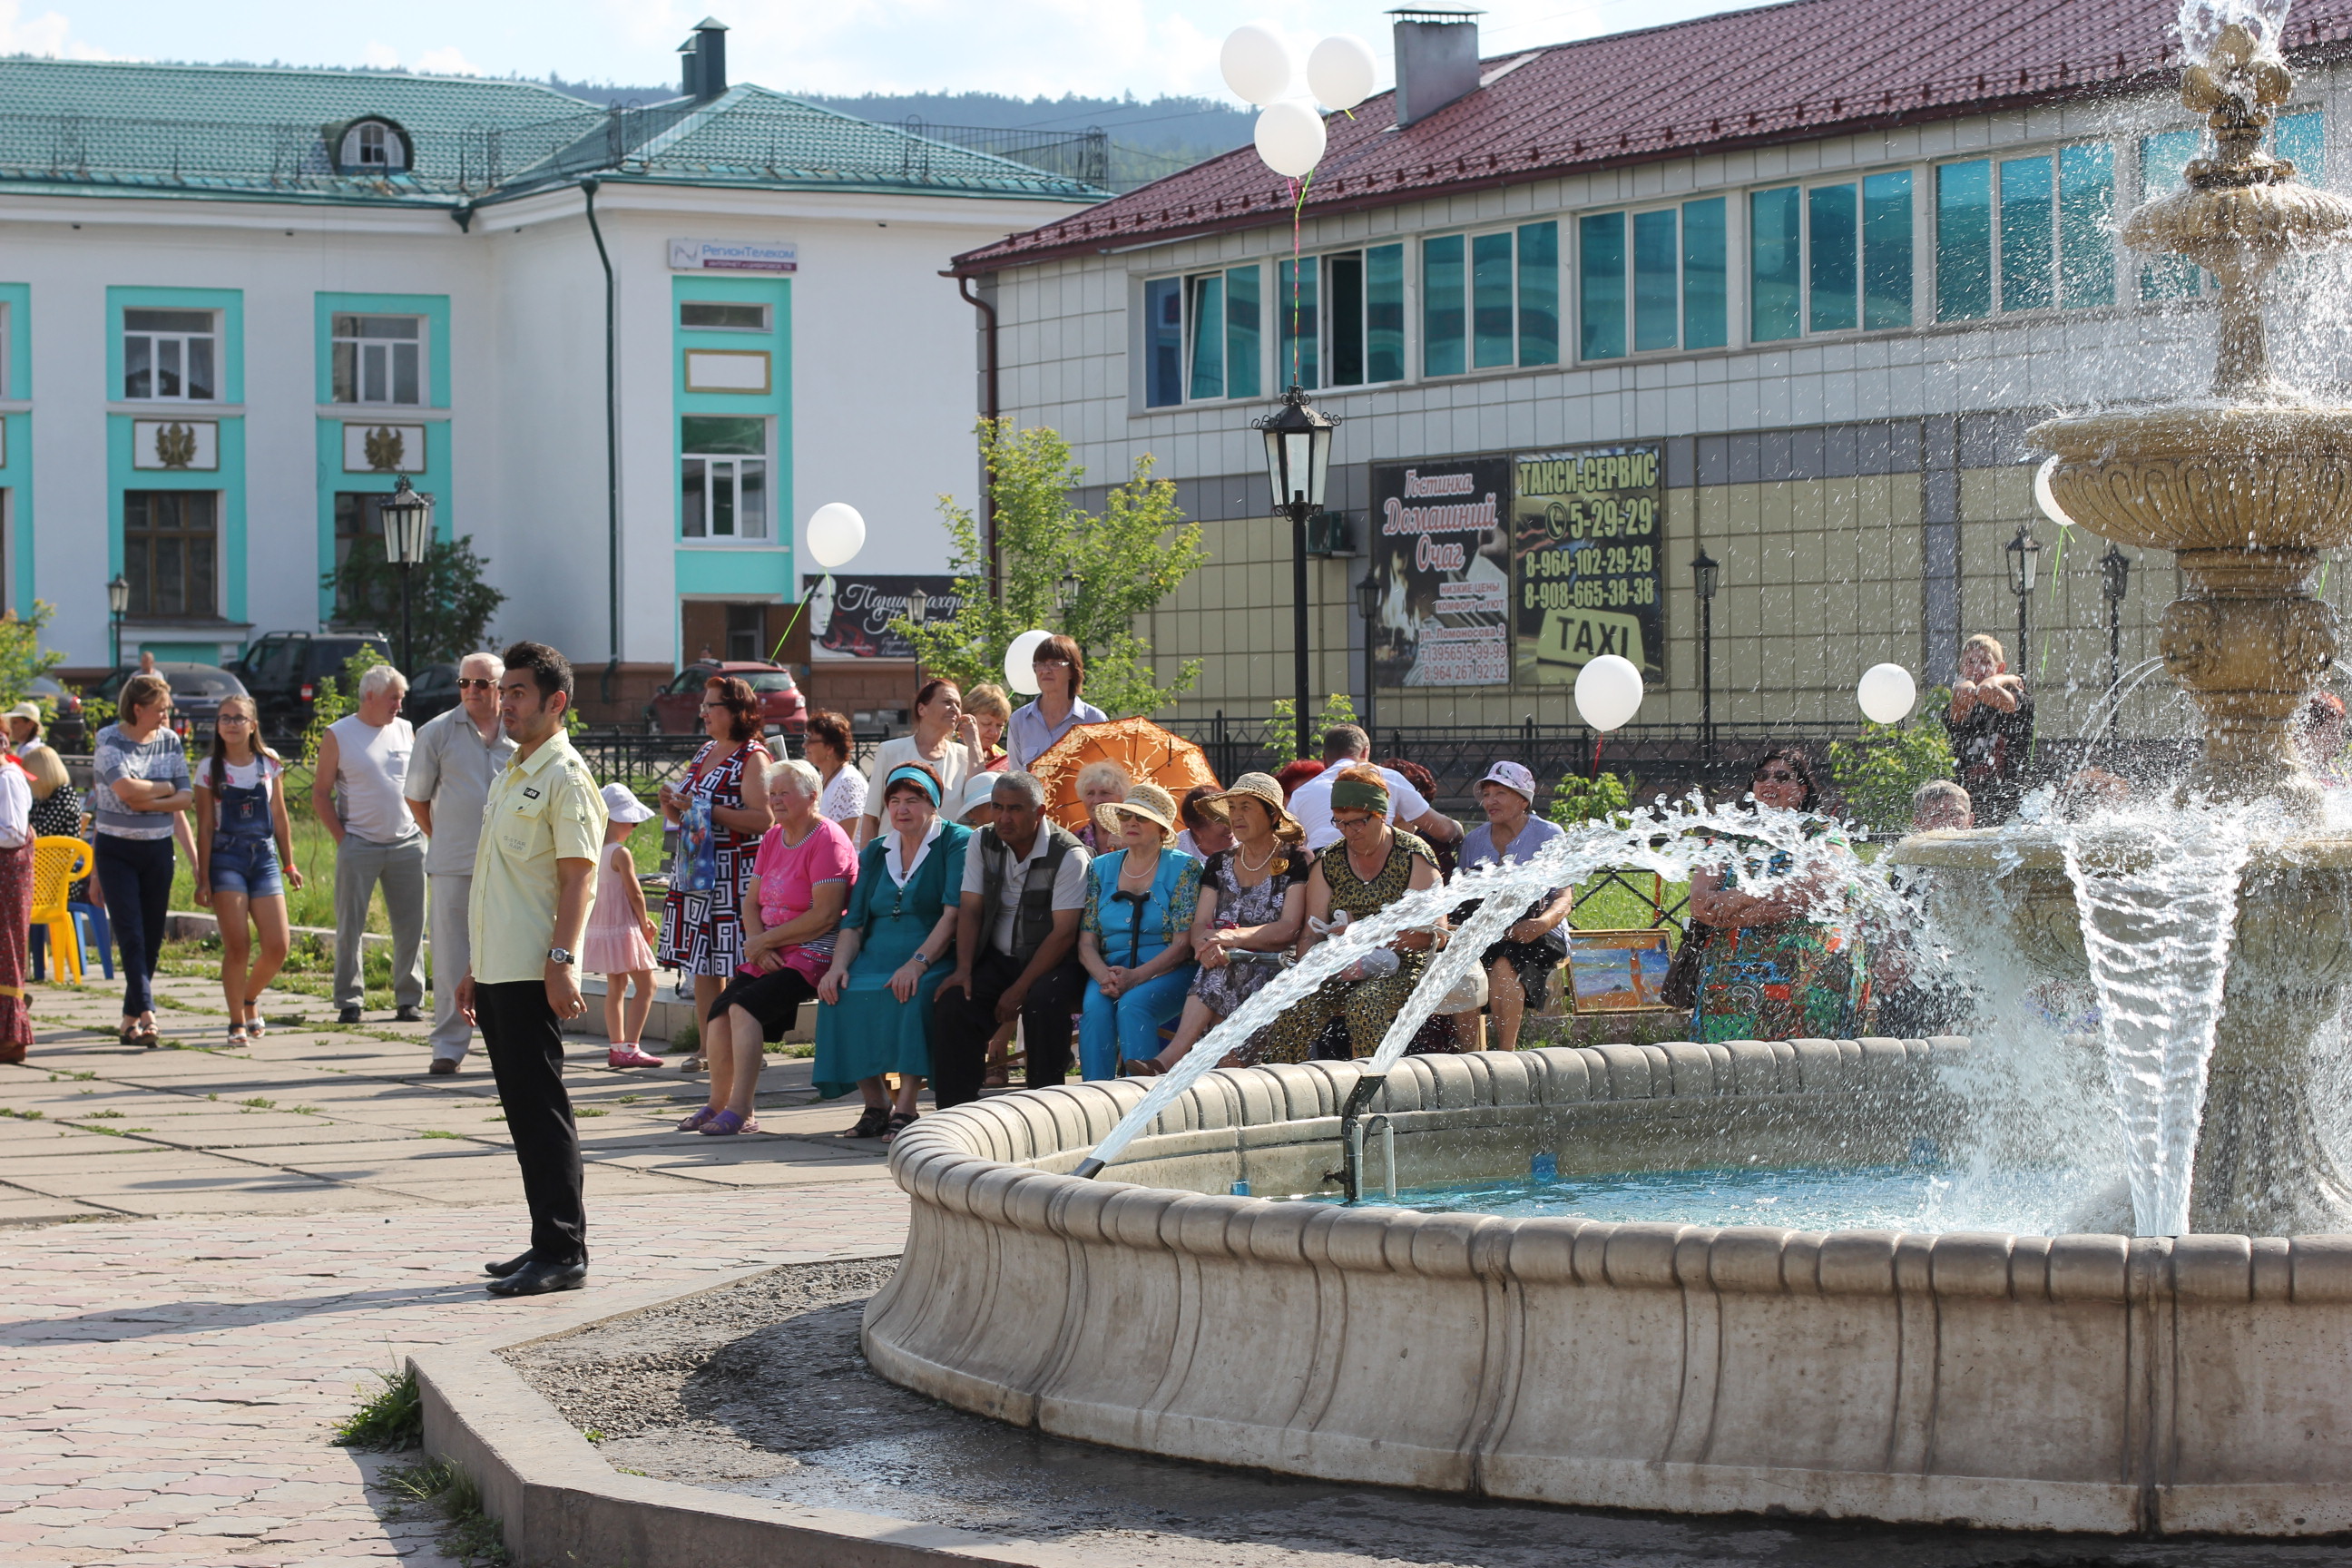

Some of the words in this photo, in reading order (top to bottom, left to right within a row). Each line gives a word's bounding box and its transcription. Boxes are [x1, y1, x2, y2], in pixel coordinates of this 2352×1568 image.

[702, 245, 794, 258] РегионТелеком
[1405, 469, 1474, 497] Гостинка
[1519, 453, 1656, 496] ТАКСИ-СЕРВИС
[1383, 493, 1498, 534] Домашний
[1570, 496, 1653, 540] 5-29-29
[1416, 534, 1465, 572] Очаг
[1525, 544, 1653, 578] 8-964-102-29-29
[1440, 583, 1473, 594] НИЗКИЕ
[1475, 583, 1500, 593] ЦЕНЫ
[1524, 577, 1655, 610] 8-908-665-38-38
[1436, 601, 1476, 612] КОМФОРТ
[1485, 599, 1504, 610] УЮТ
[1420, 630, 1434, 642] ул.
[1436, 627, 1496, 639] Ломоносова
[1498, 624, 1505, 637] 2
[1556, 615, 1629, 659] TAXI
[1424, 665, 1430, 681] 8
[1434, 665, 1452, 681] 964
[1455, 664, 1474, 680] 267
[1476, 663, 1489, 679] 92
[1493, 663, 1505, 679] 32
[508, 842, 523, 850] RAW
